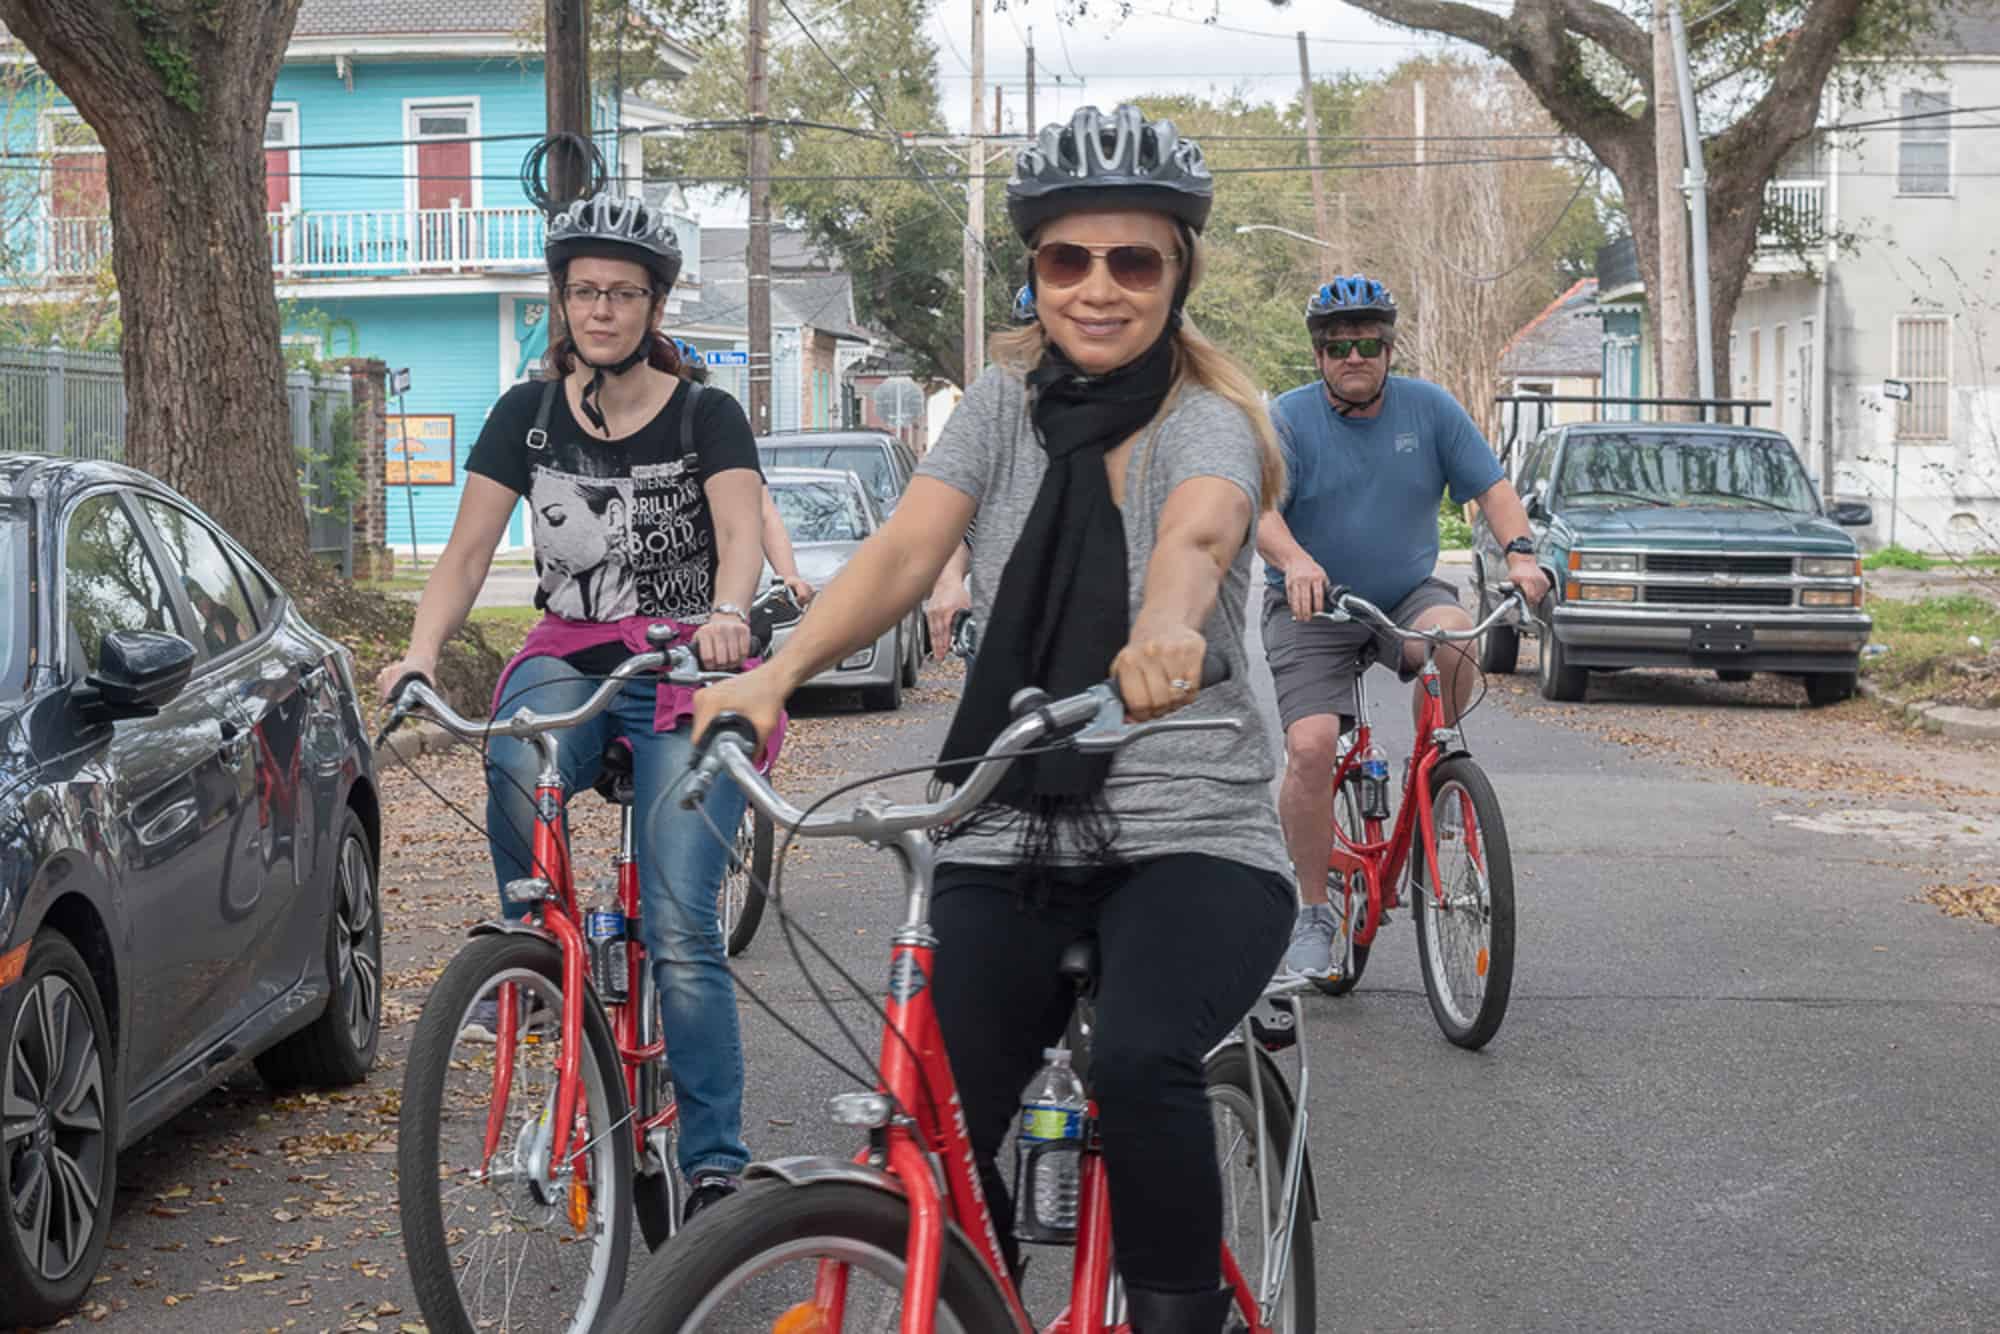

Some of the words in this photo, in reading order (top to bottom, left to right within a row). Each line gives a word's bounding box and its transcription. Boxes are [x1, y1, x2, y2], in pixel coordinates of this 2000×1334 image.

[631, 521, 694, 554] BOLD
[641, 585, 711, 615] GLOSSY
[654, 571, 709, 600] VIVID
